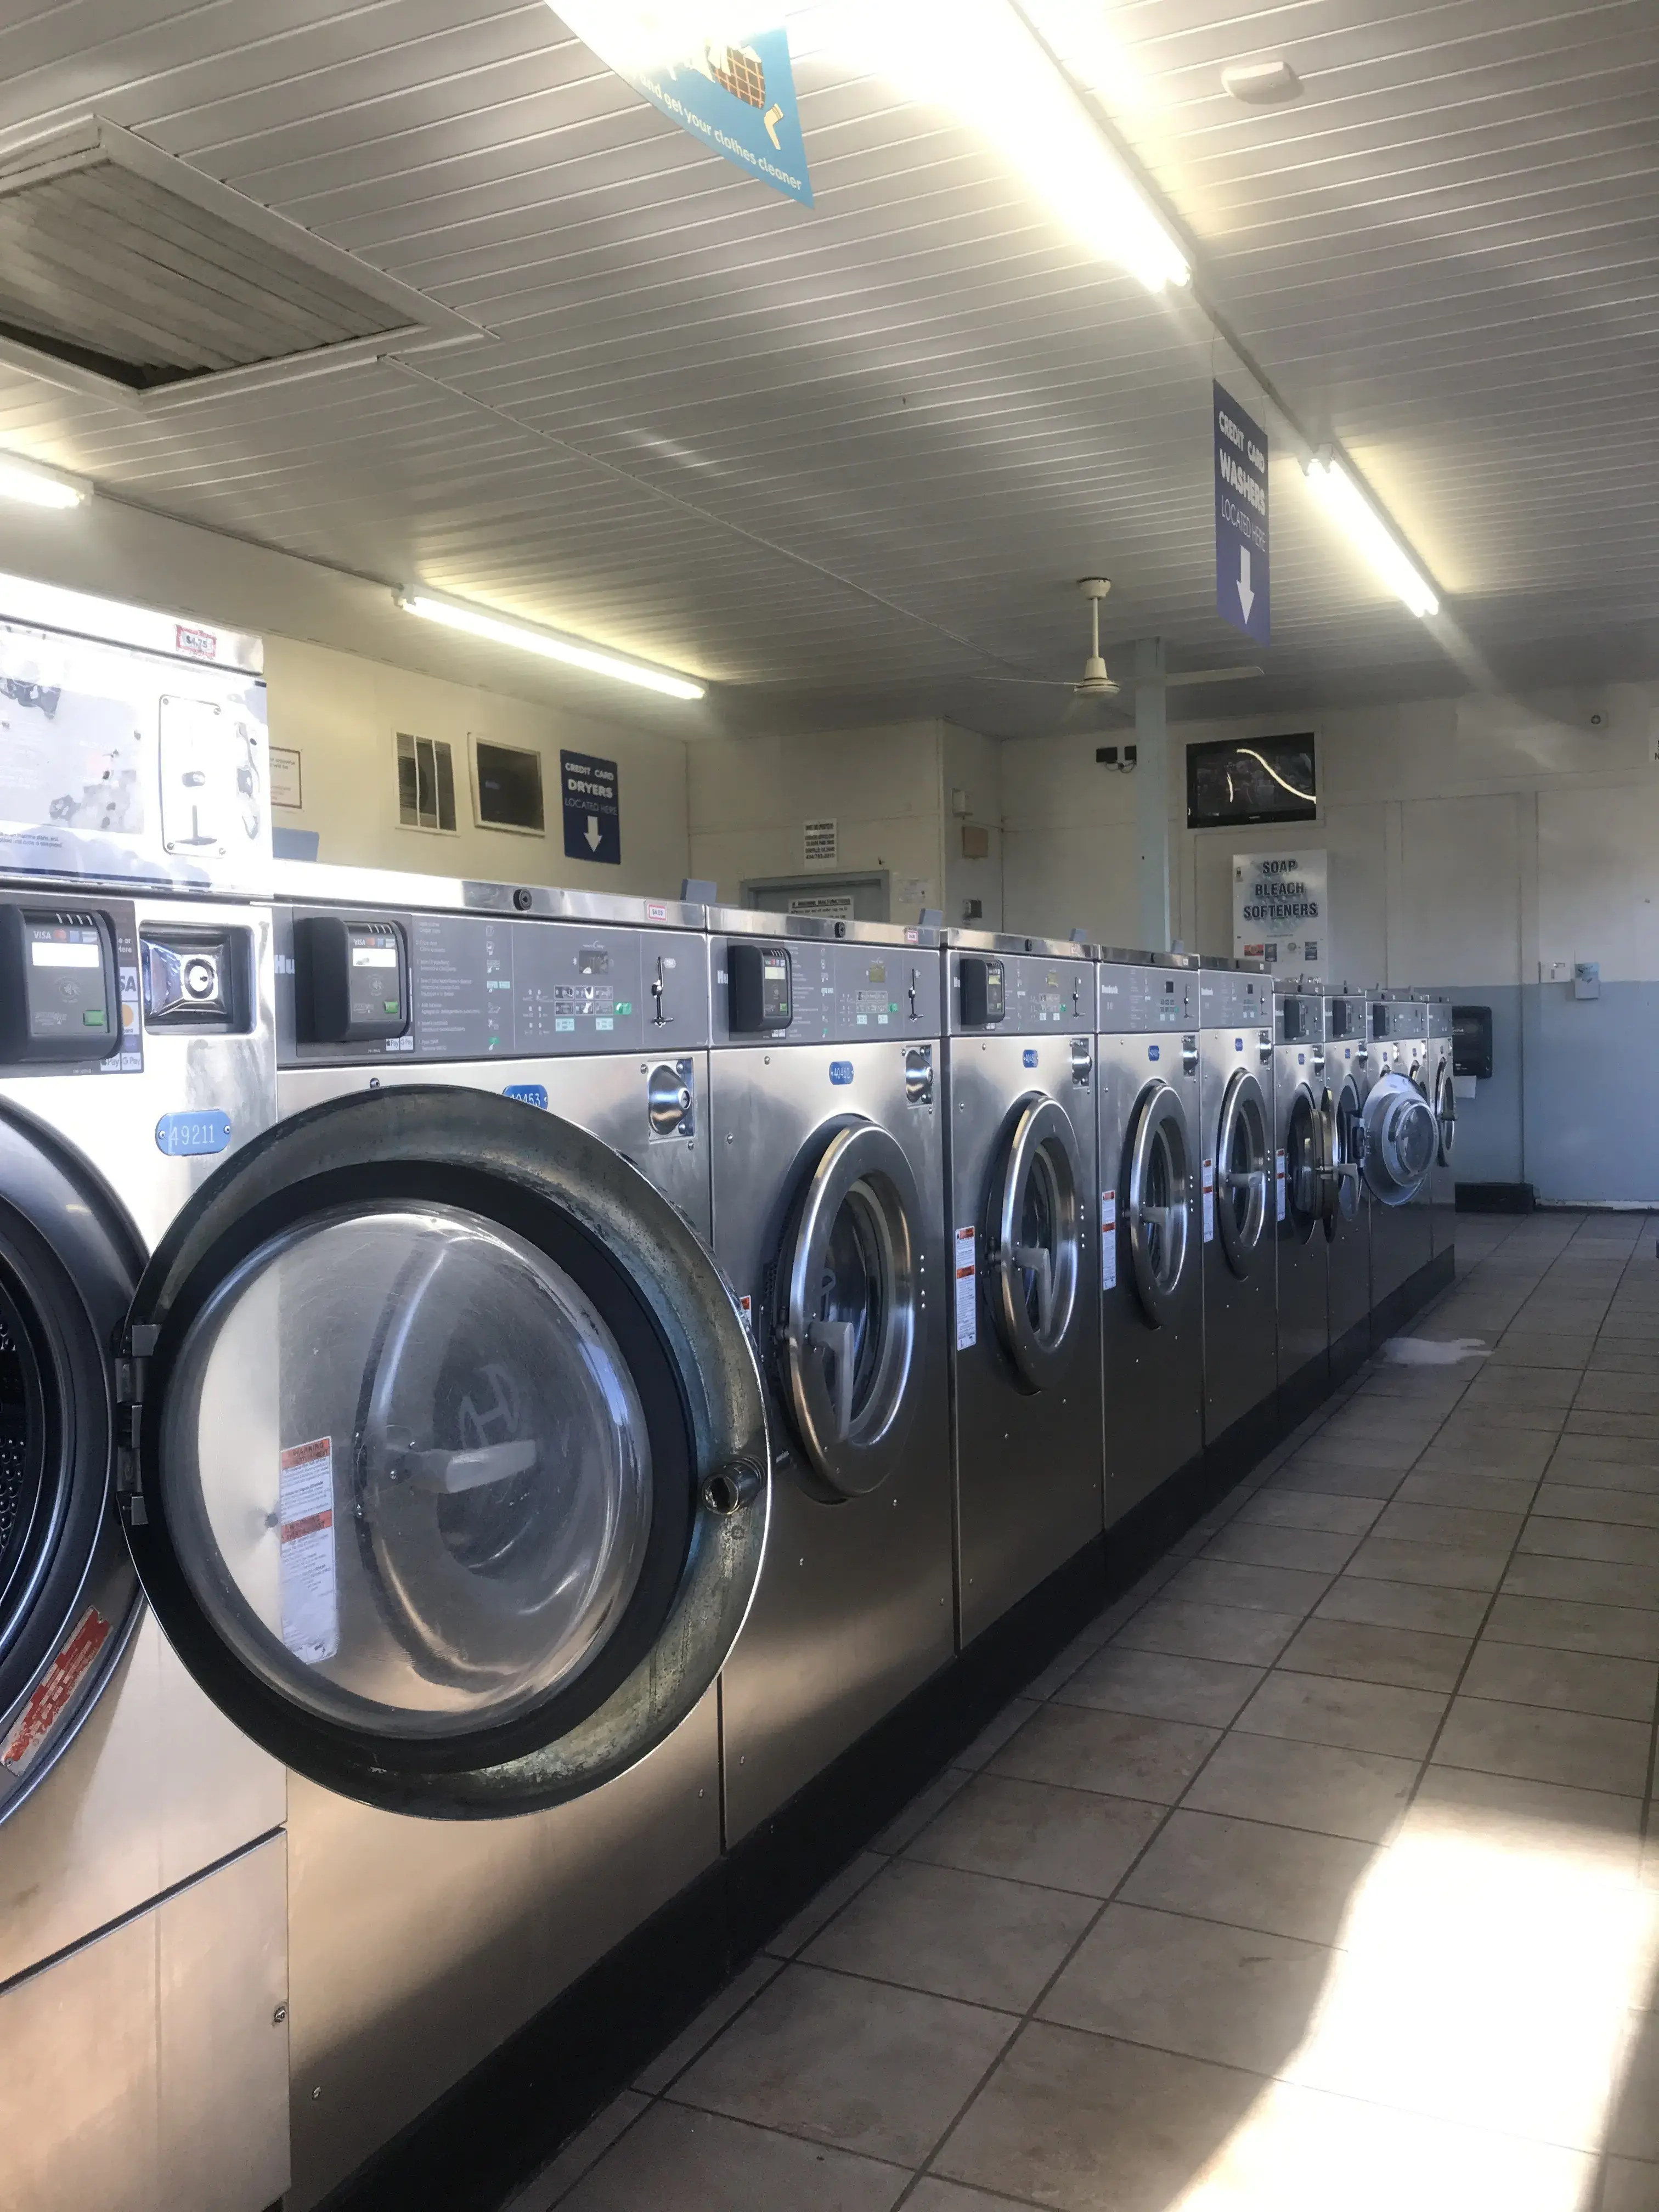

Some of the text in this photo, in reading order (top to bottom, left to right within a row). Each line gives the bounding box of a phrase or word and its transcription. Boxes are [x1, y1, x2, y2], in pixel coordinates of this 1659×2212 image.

[639, 73, 803, 191] and get your clothes cleaner
[1218, 411, 1266, 473] CREDIT CARD
[1219, 448, 1266, 516] WASHERS
[1221, 495, 1266, 552] LOCATED HERE
[186, 635, 208, 648] $4.75
[565, 763, 614, 781] CREDIT CARD
[568, 778, 613, 798] DRYERS
[565, 798, 599, 811] LOCATED
[1262, 860, 1297, 874] SOAP
[1255, 882, 1305, 895] BLEACH
[1243, 902, 1318, 918] SOFTENERS
[33, 930, 51, 940] VISA
[108, 1056, 120, 1066] Pay
[129, 1056, 140, 1065] Pay
[170, 1125, 215, 1146] 49211
[292, 1441, 324, 1457] WARNING
